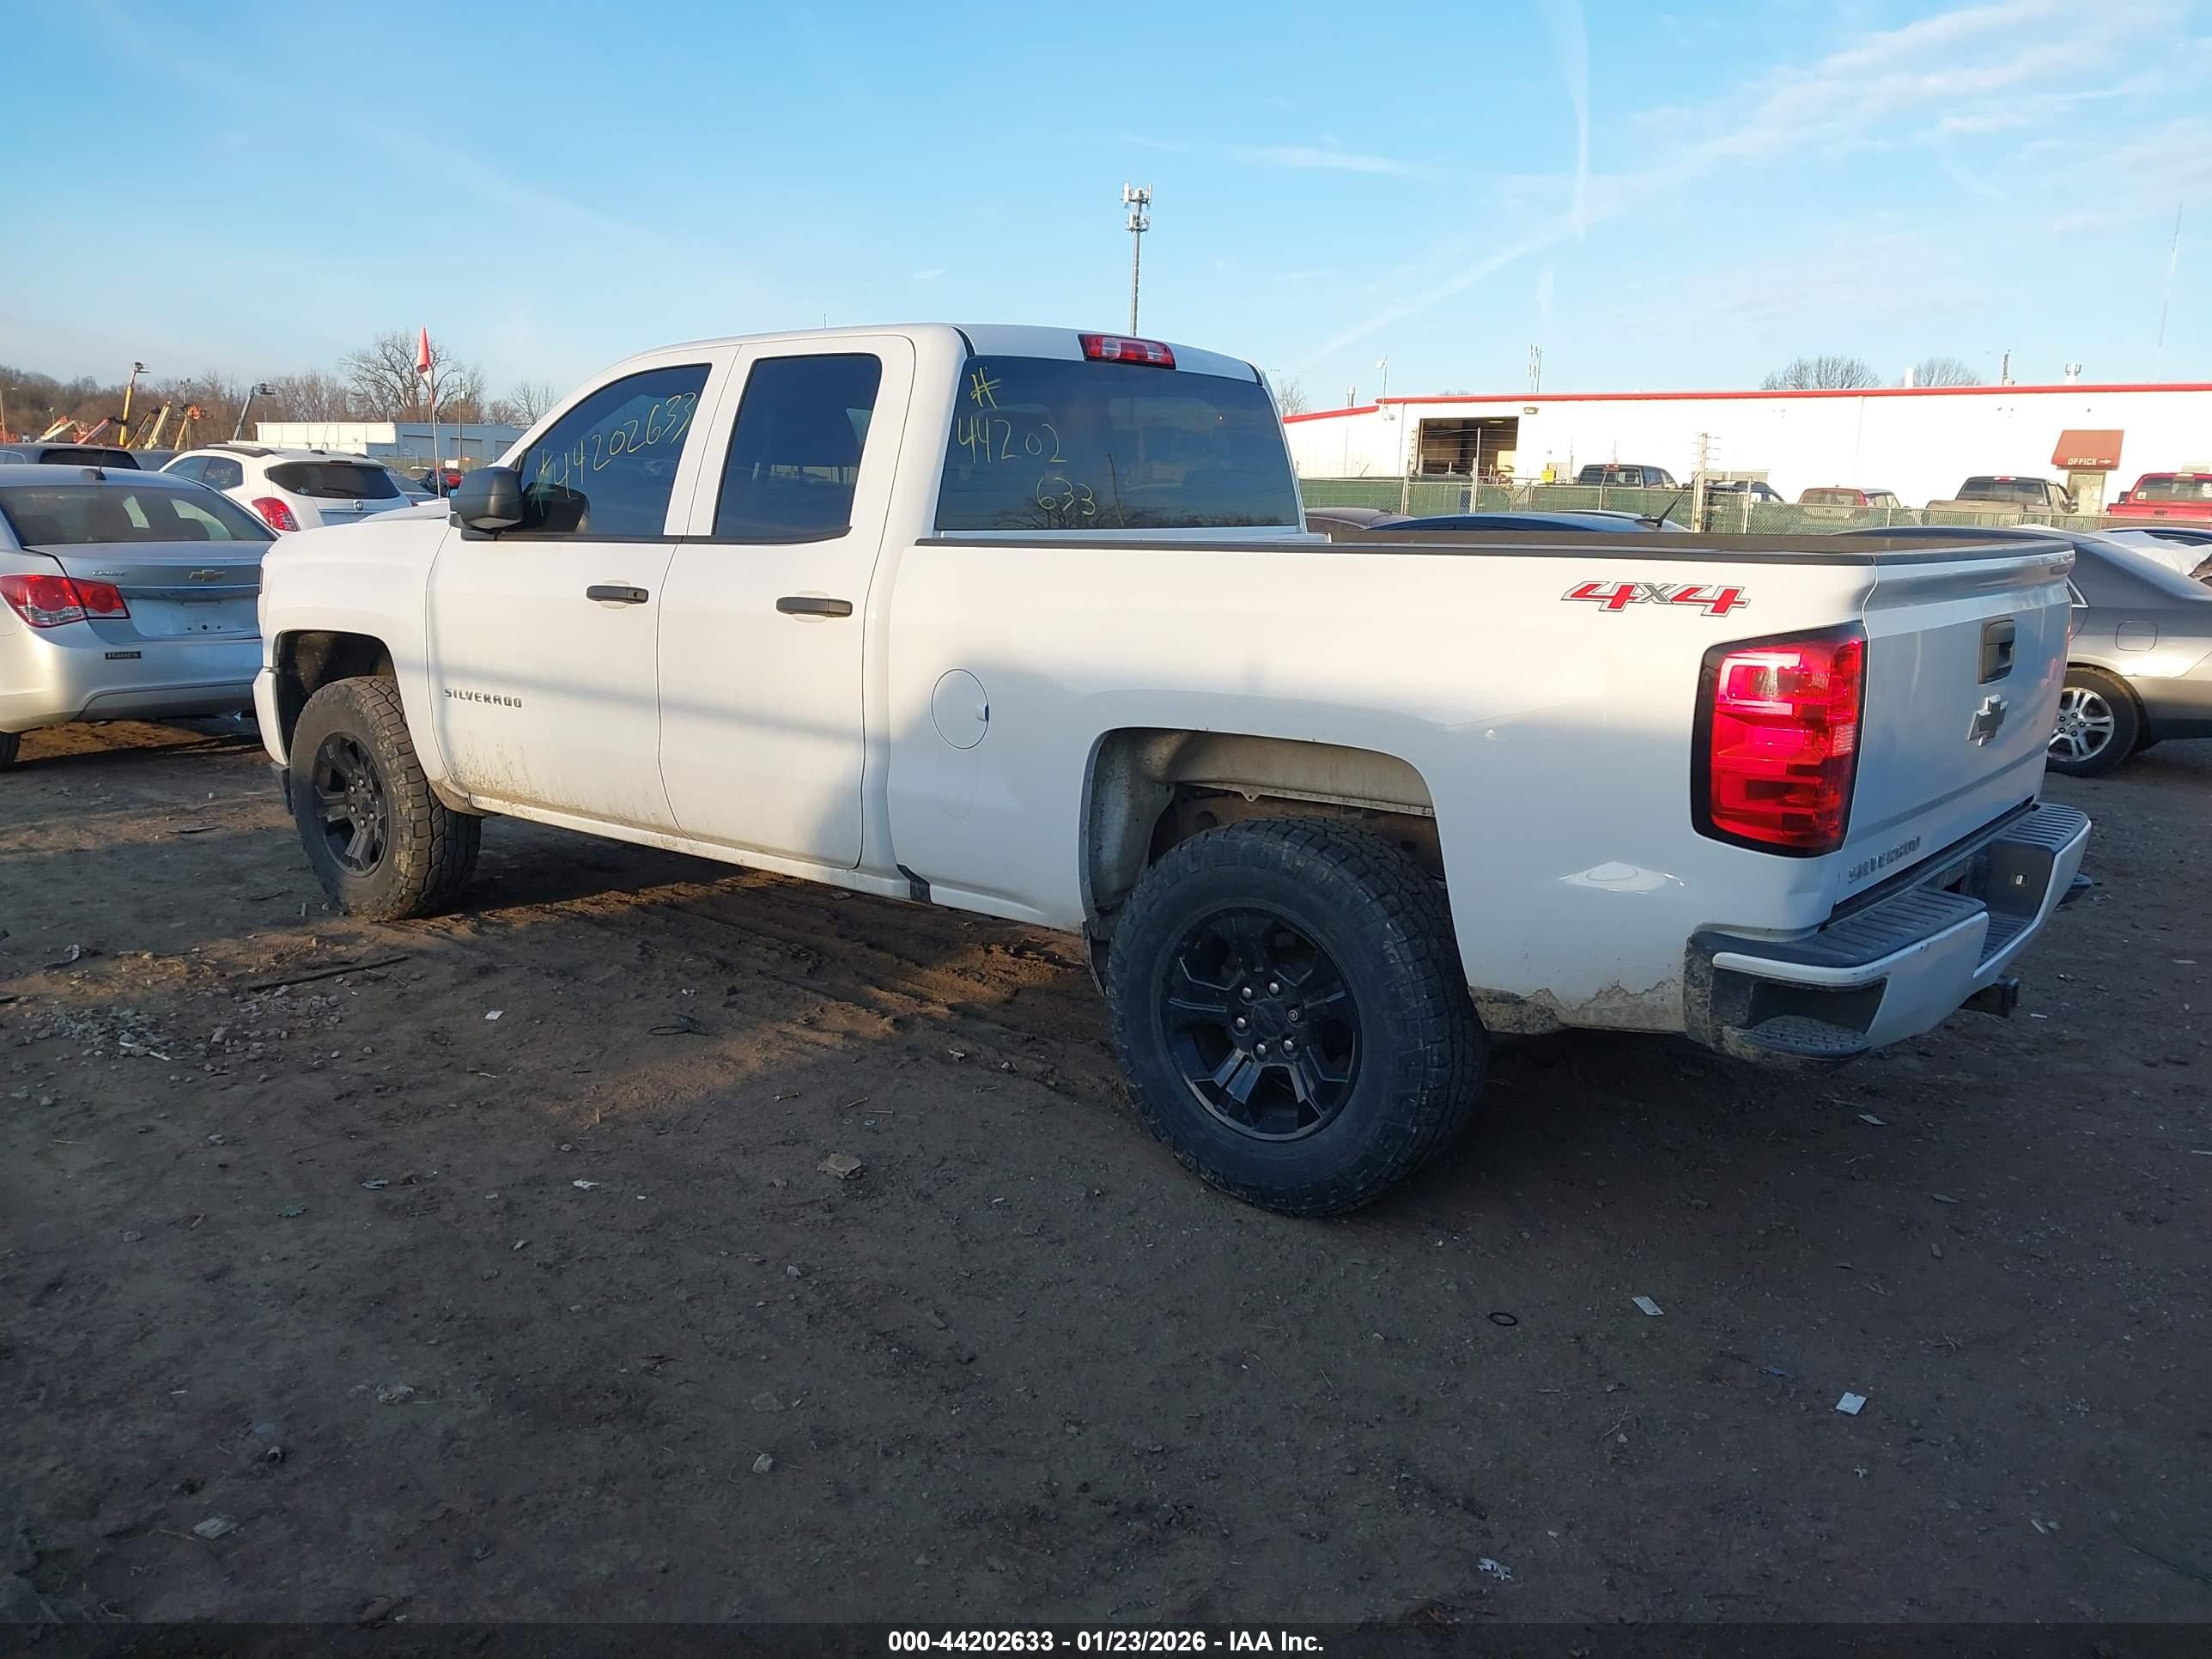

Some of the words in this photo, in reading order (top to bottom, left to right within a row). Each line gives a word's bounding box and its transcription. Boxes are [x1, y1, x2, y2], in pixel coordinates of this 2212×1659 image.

[957, 415, 1067, 464] 44202
[2067, 457, 2098, 466] OFFICE
[1036, 477, 1096, 515] 633
[444, 688, 523, 708] SILVERADO
